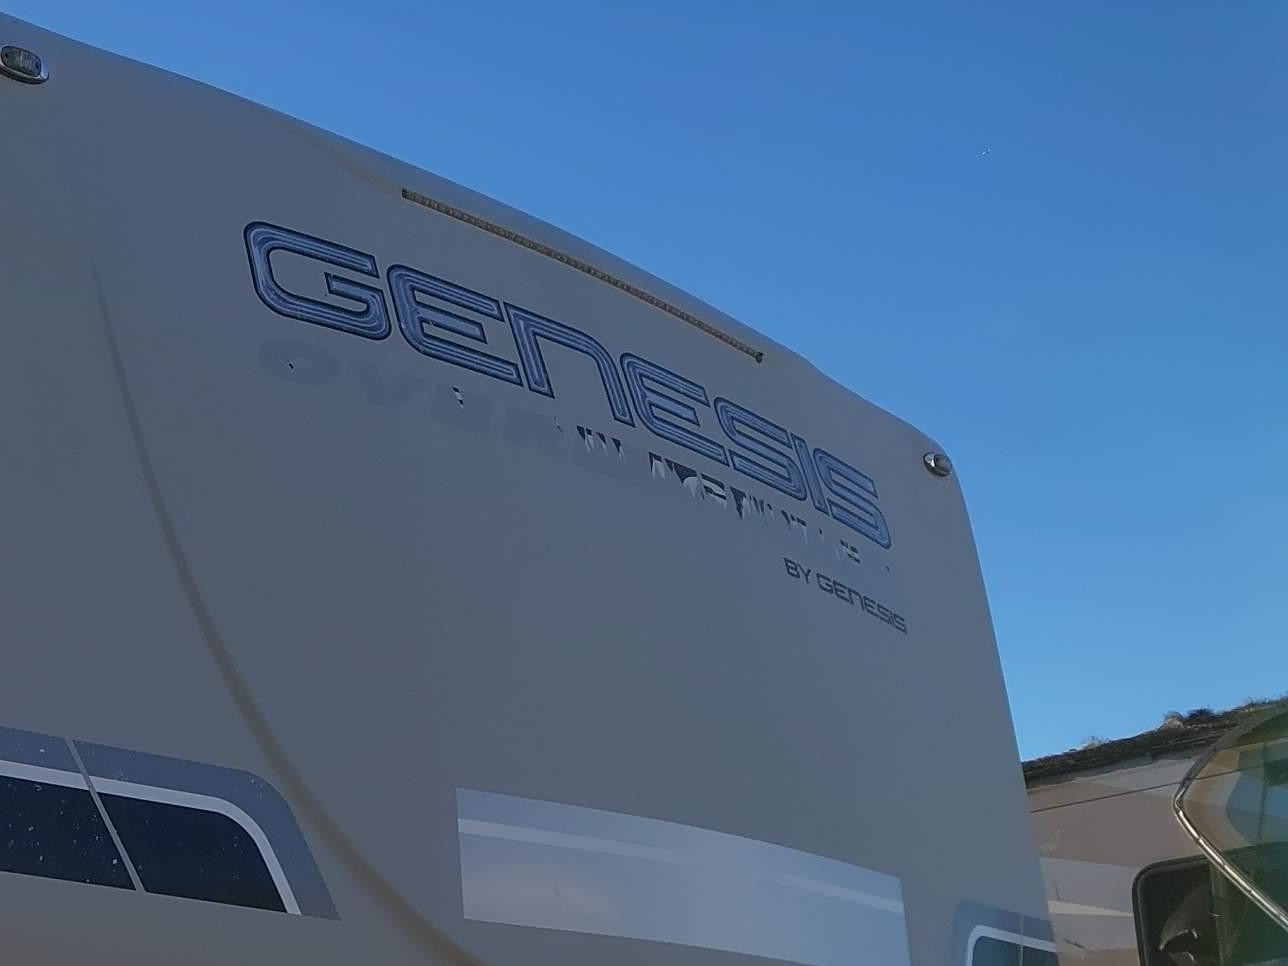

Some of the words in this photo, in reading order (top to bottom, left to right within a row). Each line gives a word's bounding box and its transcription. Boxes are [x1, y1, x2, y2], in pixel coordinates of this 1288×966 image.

[243, 221, 891, 549] GENESIS
[783, 556, 812, 584] BY
[815, 572, 909, 635] GENESIS
